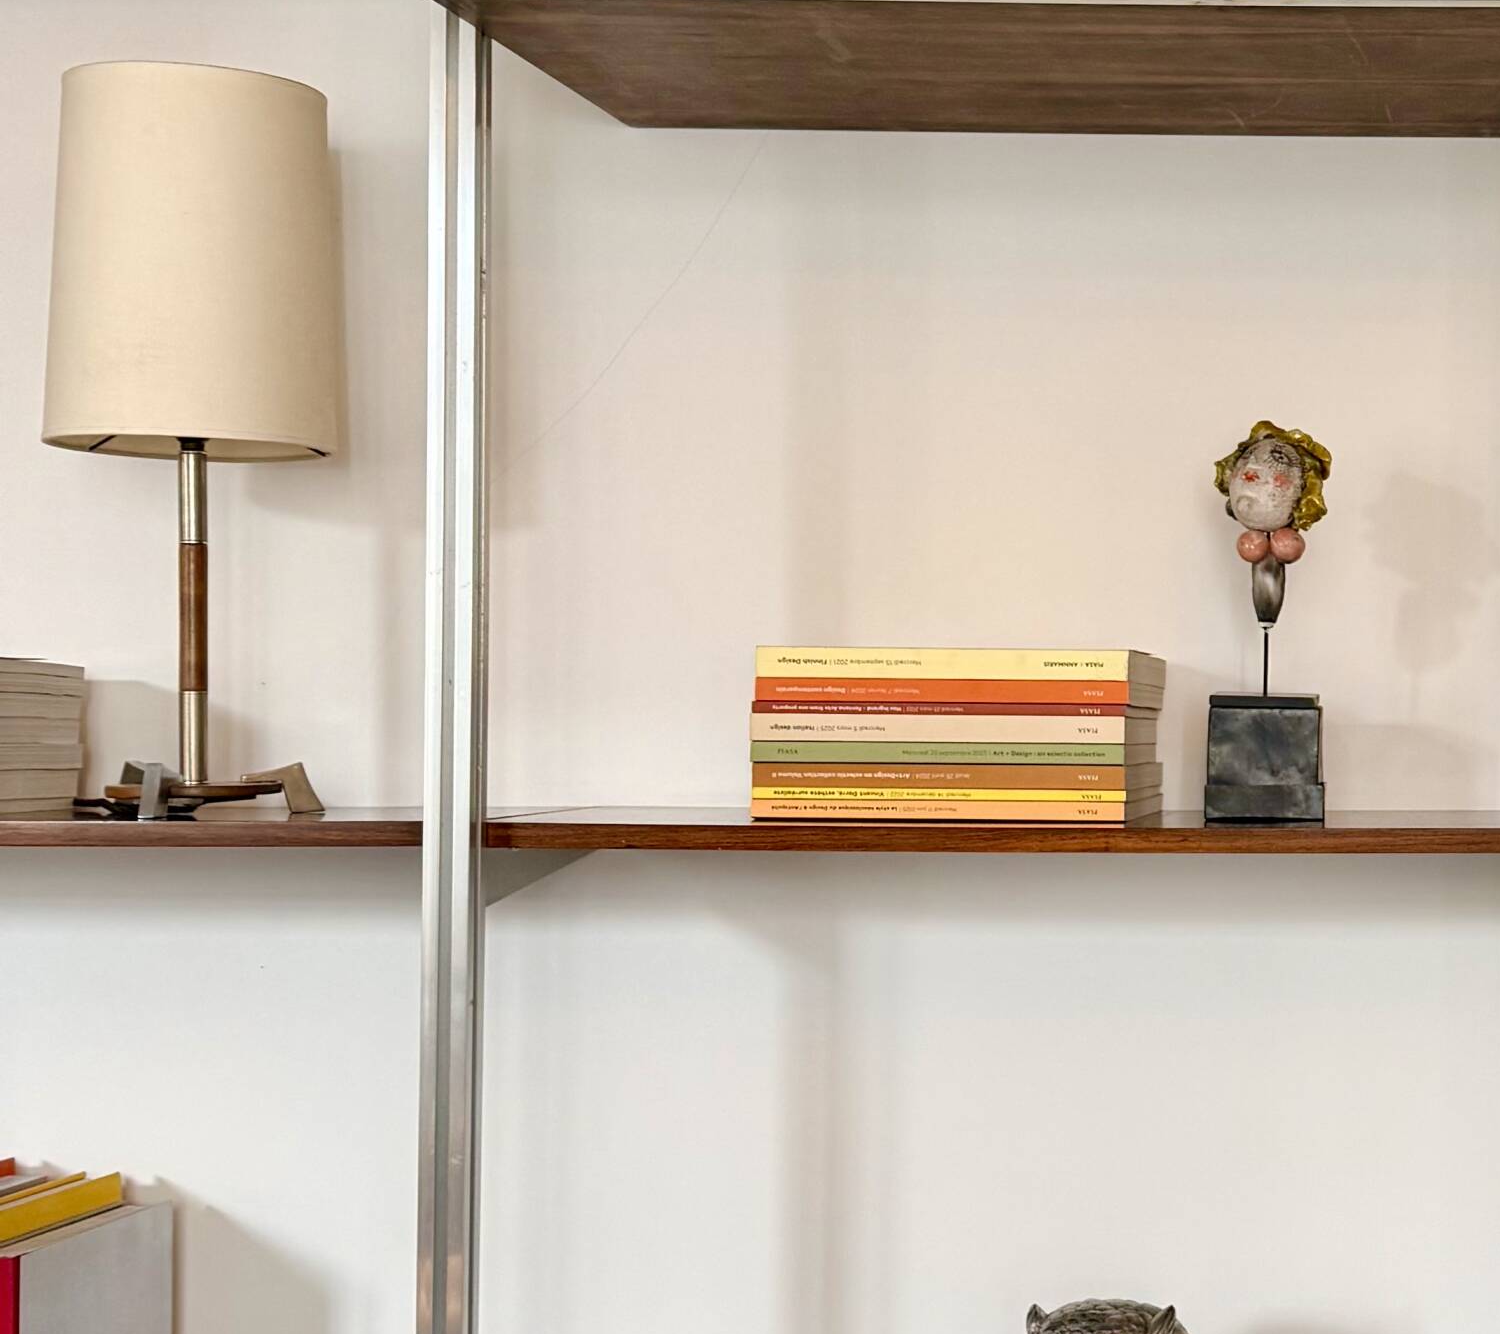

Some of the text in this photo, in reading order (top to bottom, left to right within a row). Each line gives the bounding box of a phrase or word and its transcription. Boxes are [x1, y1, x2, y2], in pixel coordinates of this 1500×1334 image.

[777, 656, 801, 665] Design
[802, 658, 828, 666] Finnish
[824, 686, 846, 694] Design
